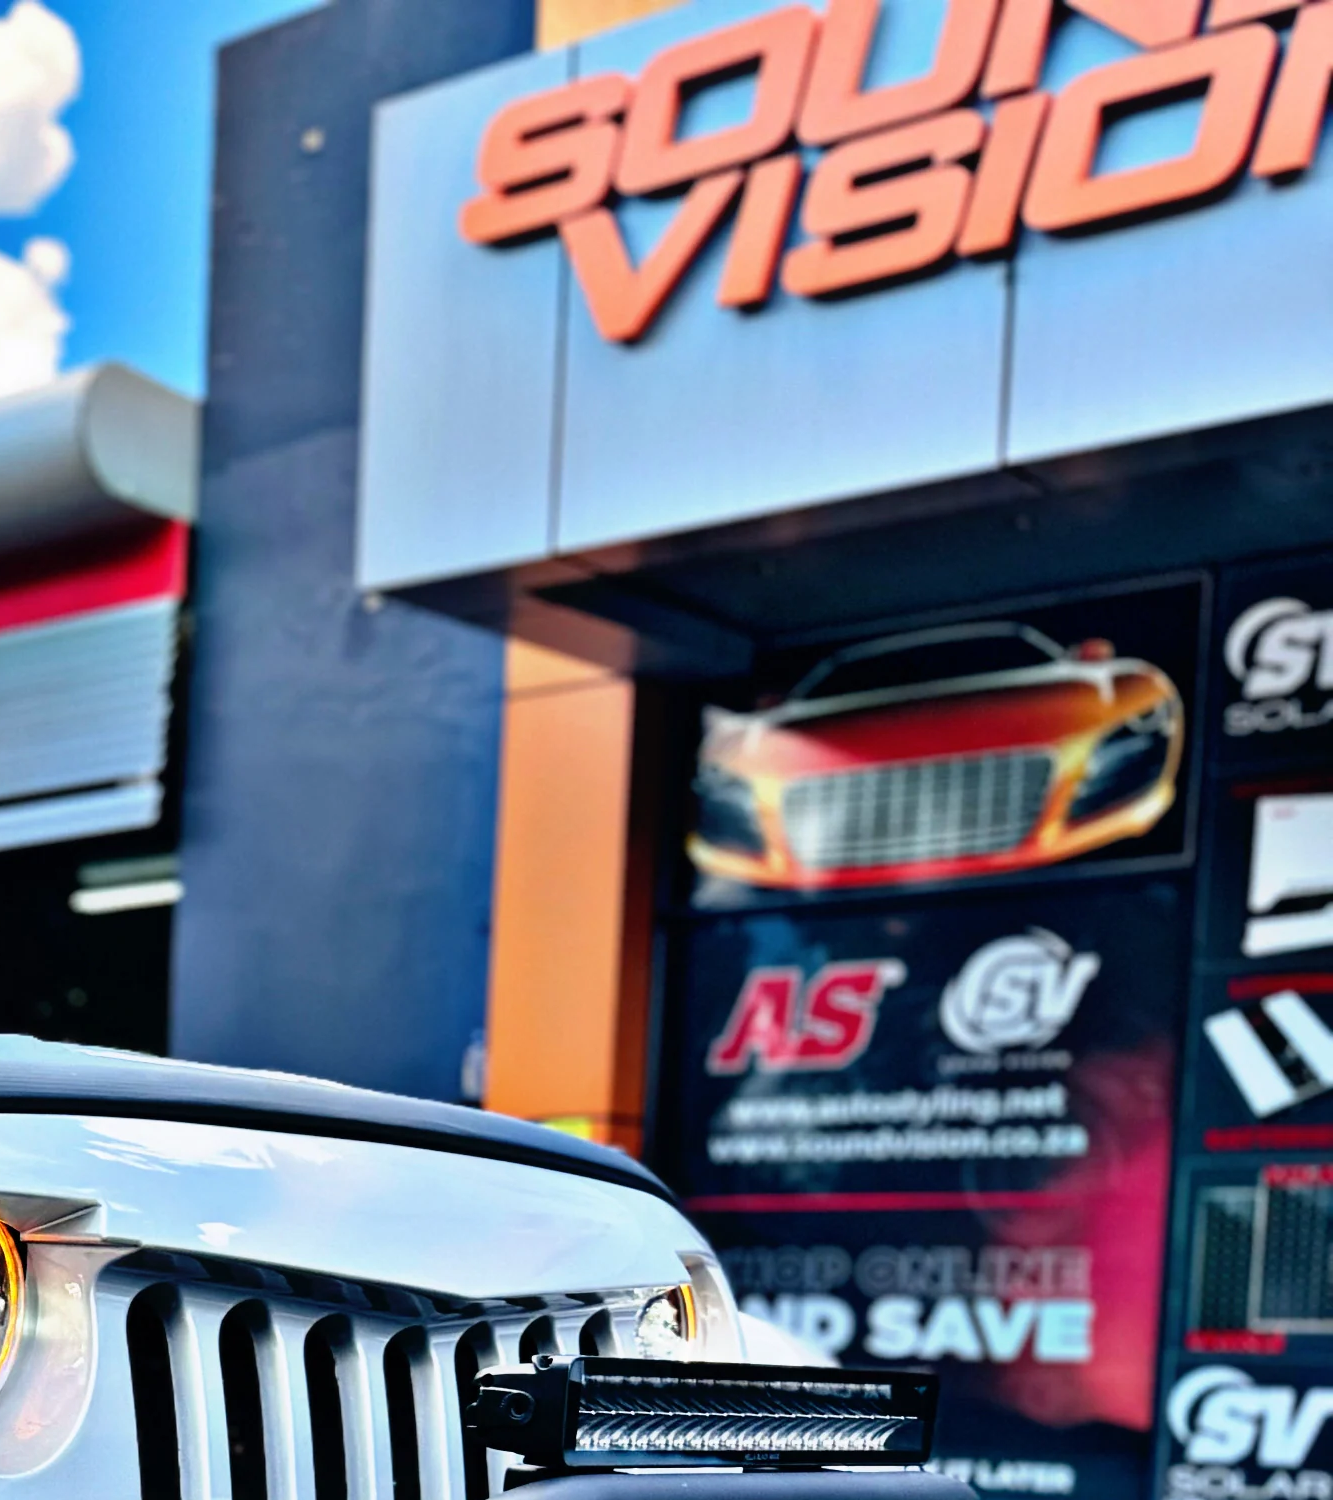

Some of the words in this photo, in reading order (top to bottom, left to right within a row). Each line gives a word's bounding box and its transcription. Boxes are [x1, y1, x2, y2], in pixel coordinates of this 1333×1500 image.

[458, 0, 1327, 244] SOU
[854, 1245, 1093, 1298] ONLINE
[736, 1292, 857, 1360] ND
[862, 1294, 1095, 1363] SAVE
